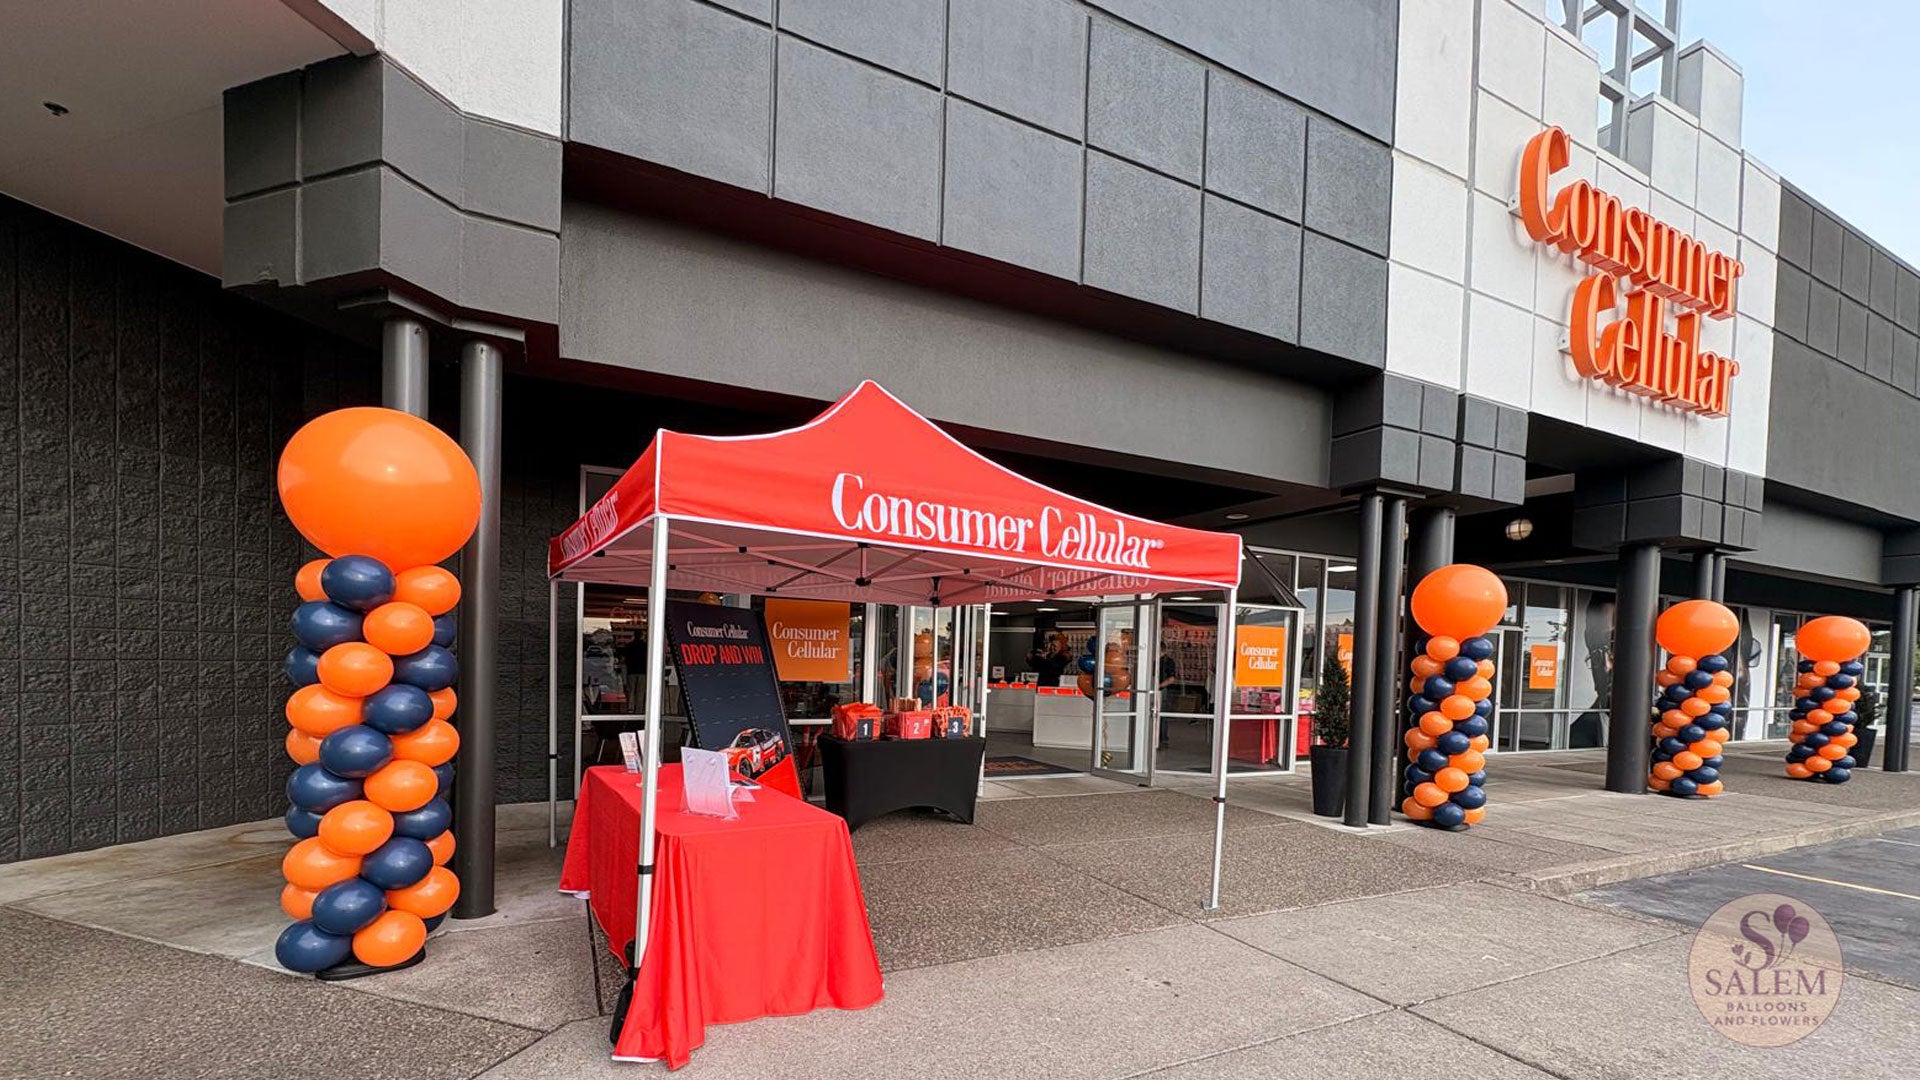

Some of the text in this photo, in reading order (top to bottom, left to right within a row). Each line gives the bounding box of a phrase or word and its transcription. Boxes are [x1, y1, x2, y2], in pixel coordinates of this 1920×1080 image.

[1520, 126, 1744, 321] Consumer
[1569, 271, 1739, 419] Cellular
[831, 472, 1034, 554] Consumer
[686, 620, 723, 638] Consumer
[772, 621, 840, 640] Consumer
[680, 643, 764, 665] DROP AND WIN
[1240, 642, 1279, 657] Consumer
[862, 722, 869, 736] 1
[912, 721, 921, 735] 2
[951, 720, 960, 734] 3
